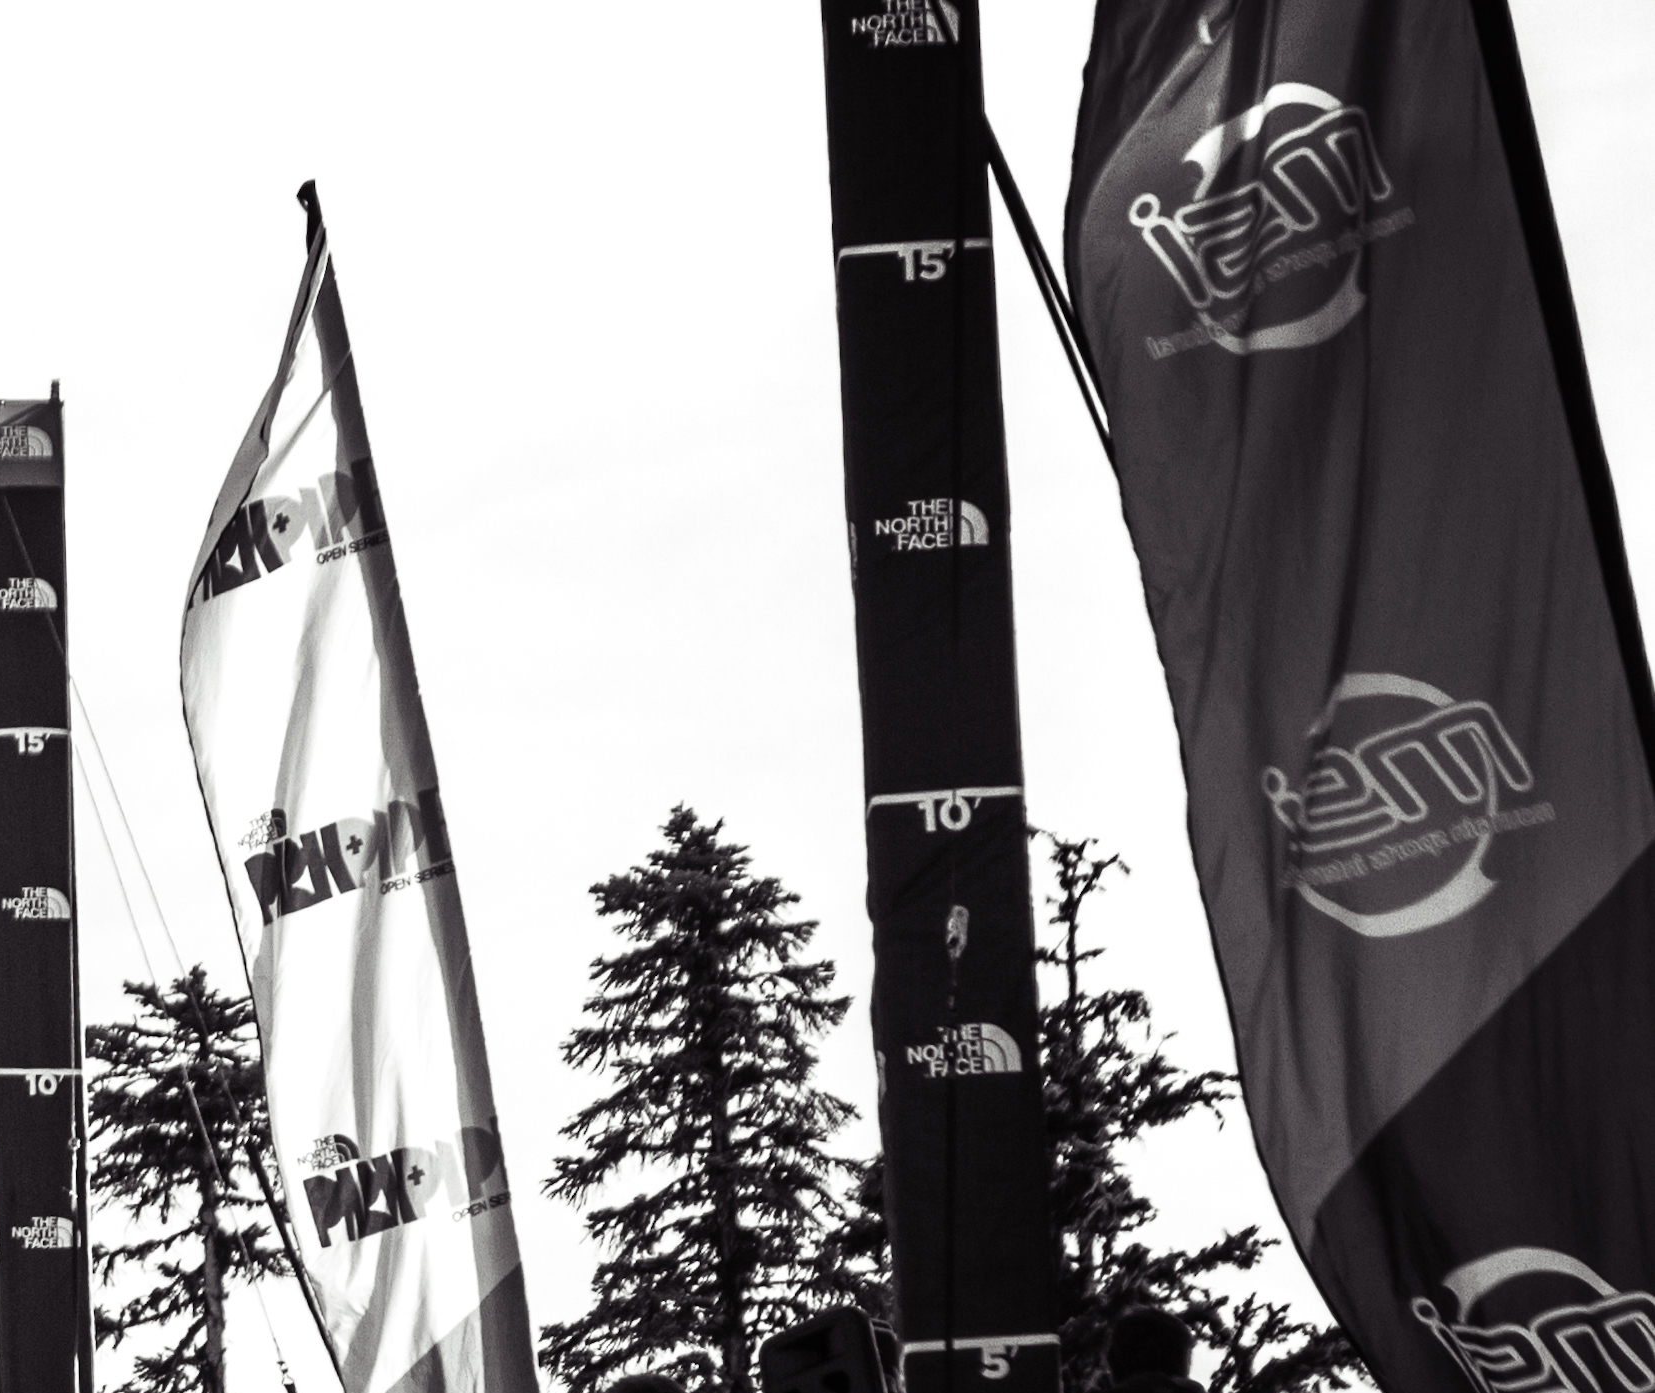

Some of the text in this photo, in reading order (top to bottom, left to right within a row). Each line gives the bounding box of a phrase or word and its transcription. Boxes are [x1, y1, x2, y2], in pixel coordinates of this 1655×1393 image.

[851, 12, 924, 35] NORTH
[874, 28, 924, 47] FACE
[2, 425, 29, 437] THE
[908, 499, 951, 516] THE
[875, 515, 951, 535] NORTH
[897, 532, 951, 550] FACE
[8, 577, 34, 588] THE
[1, 598, 35, 610] FACE
[22, 886, 47, 898] THE
[1, 897, 48, 911] NORTH
[14, 908, 48, 920] FACE
[906, 1038, 982, 1064] NOTH
[32, 1215, 58, 1228] THE
[11, 1226, 58, 1239] NORTH
[23, 1237, 58, 1249] FACE
